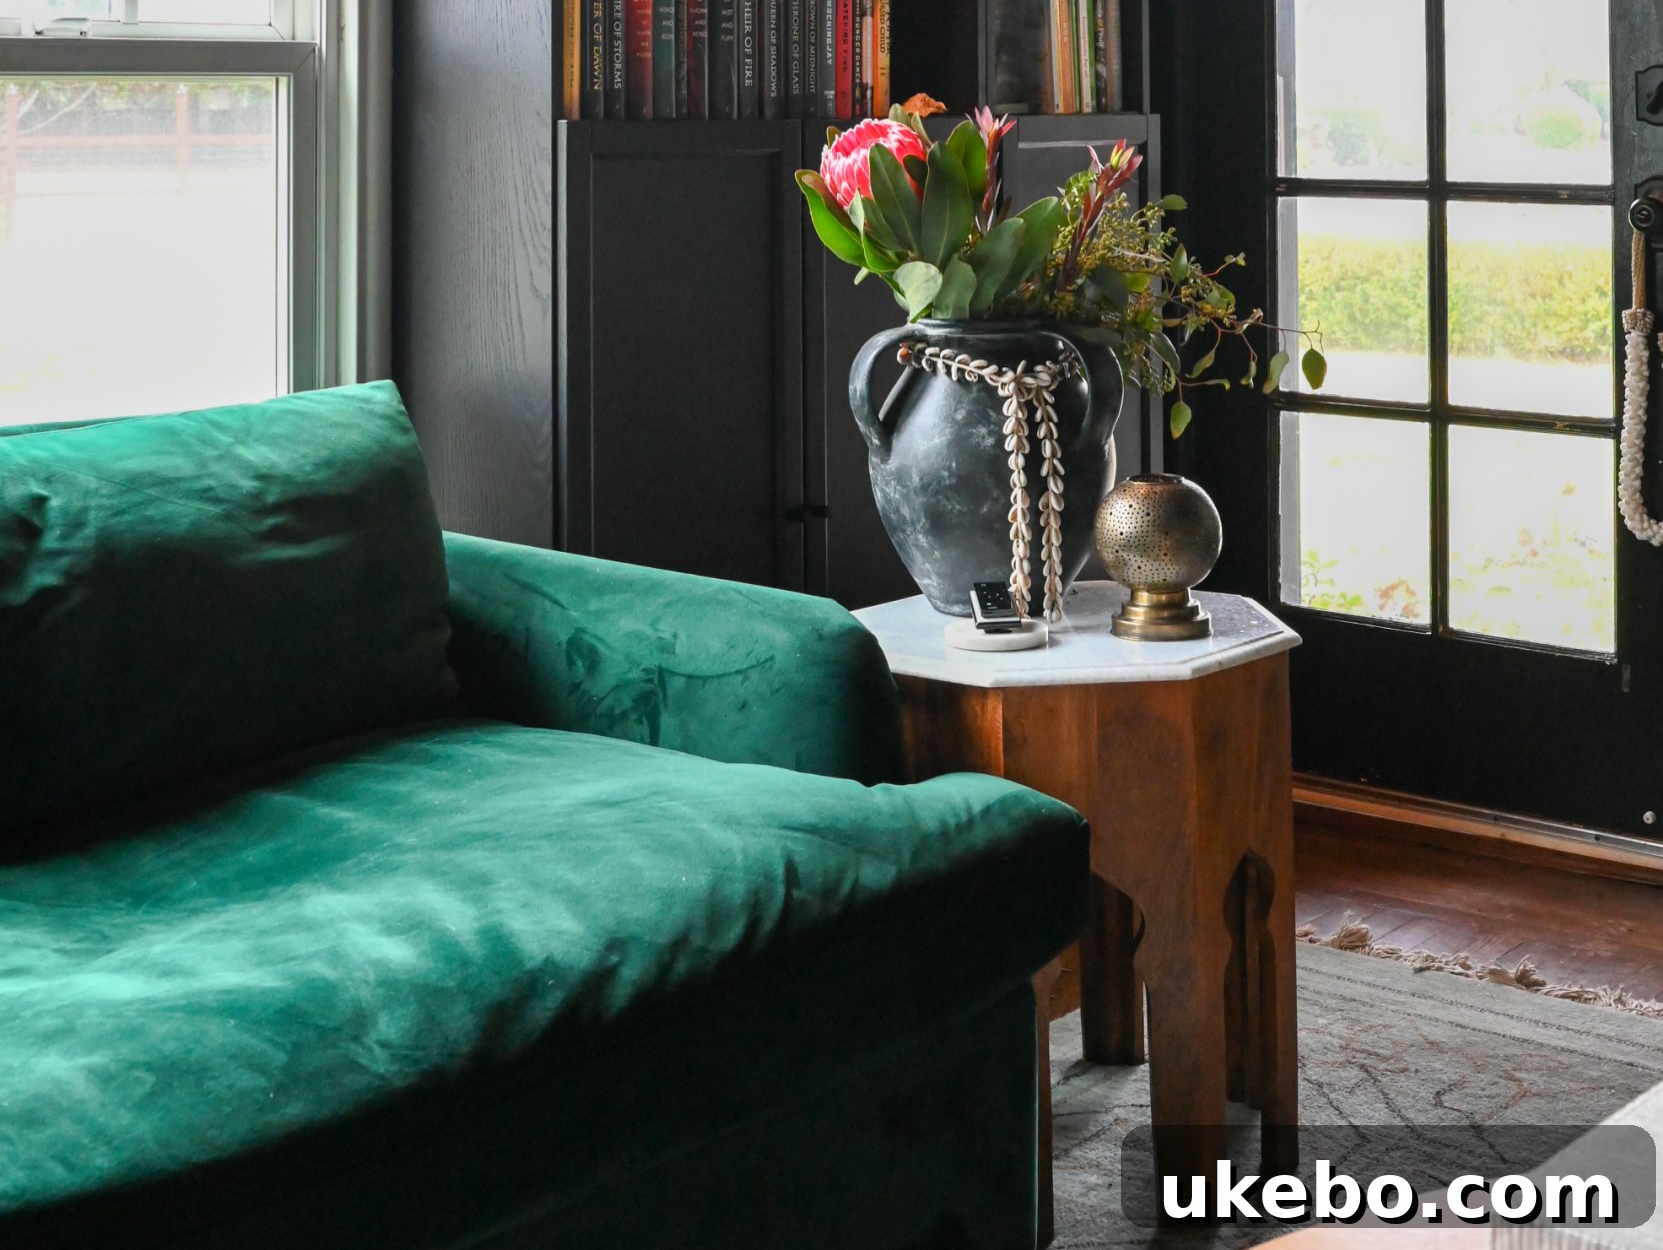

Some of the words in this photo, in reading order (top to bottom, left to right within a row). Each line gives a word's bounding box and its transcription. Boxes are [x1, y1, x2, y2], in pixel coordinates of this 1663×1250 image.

[613, 21, 622, 37] OF
[744, 1, 753, 32] HEIR
[592, 23, 602, 42] OF
[744, 36, 753, 55] OF
[769, 29, 777, 44] OF
[809, 30, 816, 44] OF
[878, 26, 886, 54] CHILD
[613, 40, 622, 90] STORMS
[791, 44, 799, 59] OF
[592, 46, 602, 91] DAWN
[744, 58, 753, 88] FIRE
[769, 45, 777, 98] SHADOWS
[791, 60, 799, 95] GLASS
